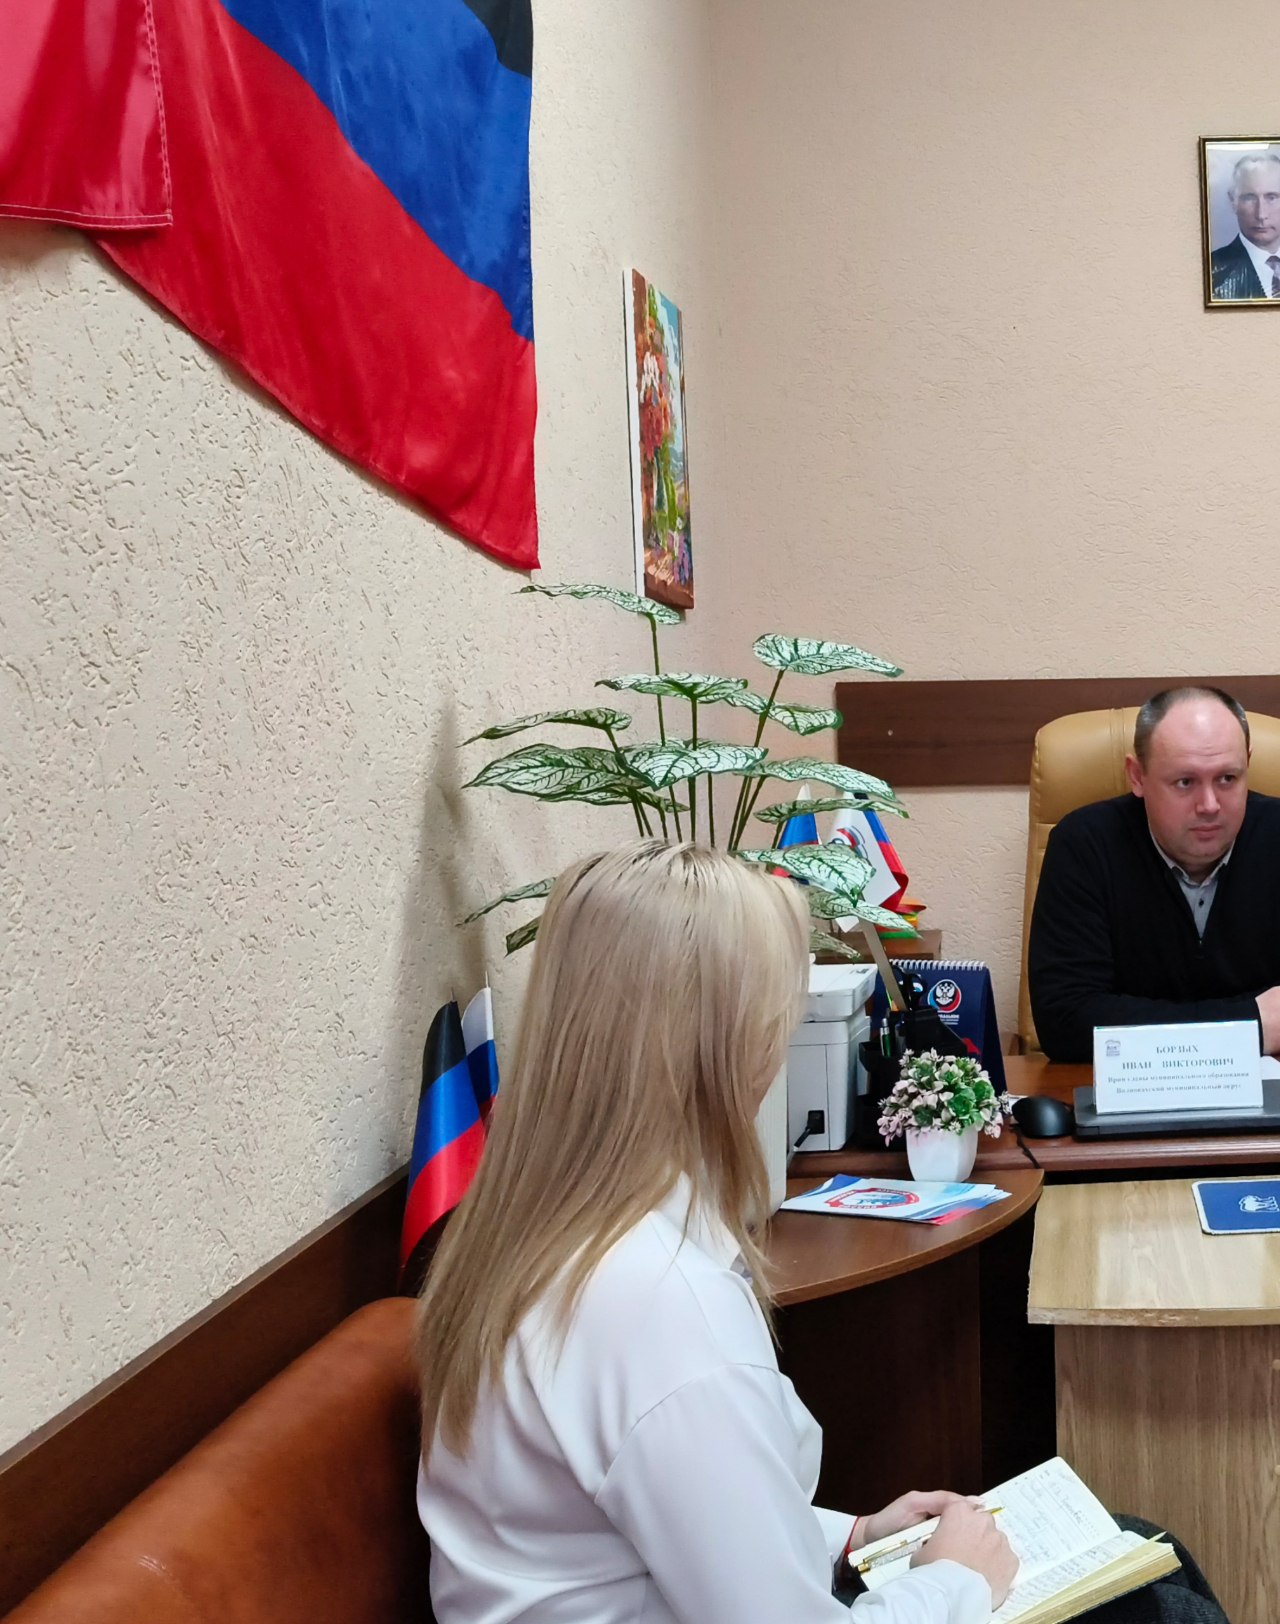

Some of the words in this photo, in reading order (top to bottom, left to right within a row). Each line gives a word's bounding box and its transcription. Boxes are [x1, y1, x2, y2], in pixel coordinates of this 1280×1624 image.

[1156, 1045, 1198, 1054] БОРЗЫХ
[1122, 1062, 1151, 1070] ИВАН
[1162, 1059, 1234, 1068] ВИКТОРОВИЧ
